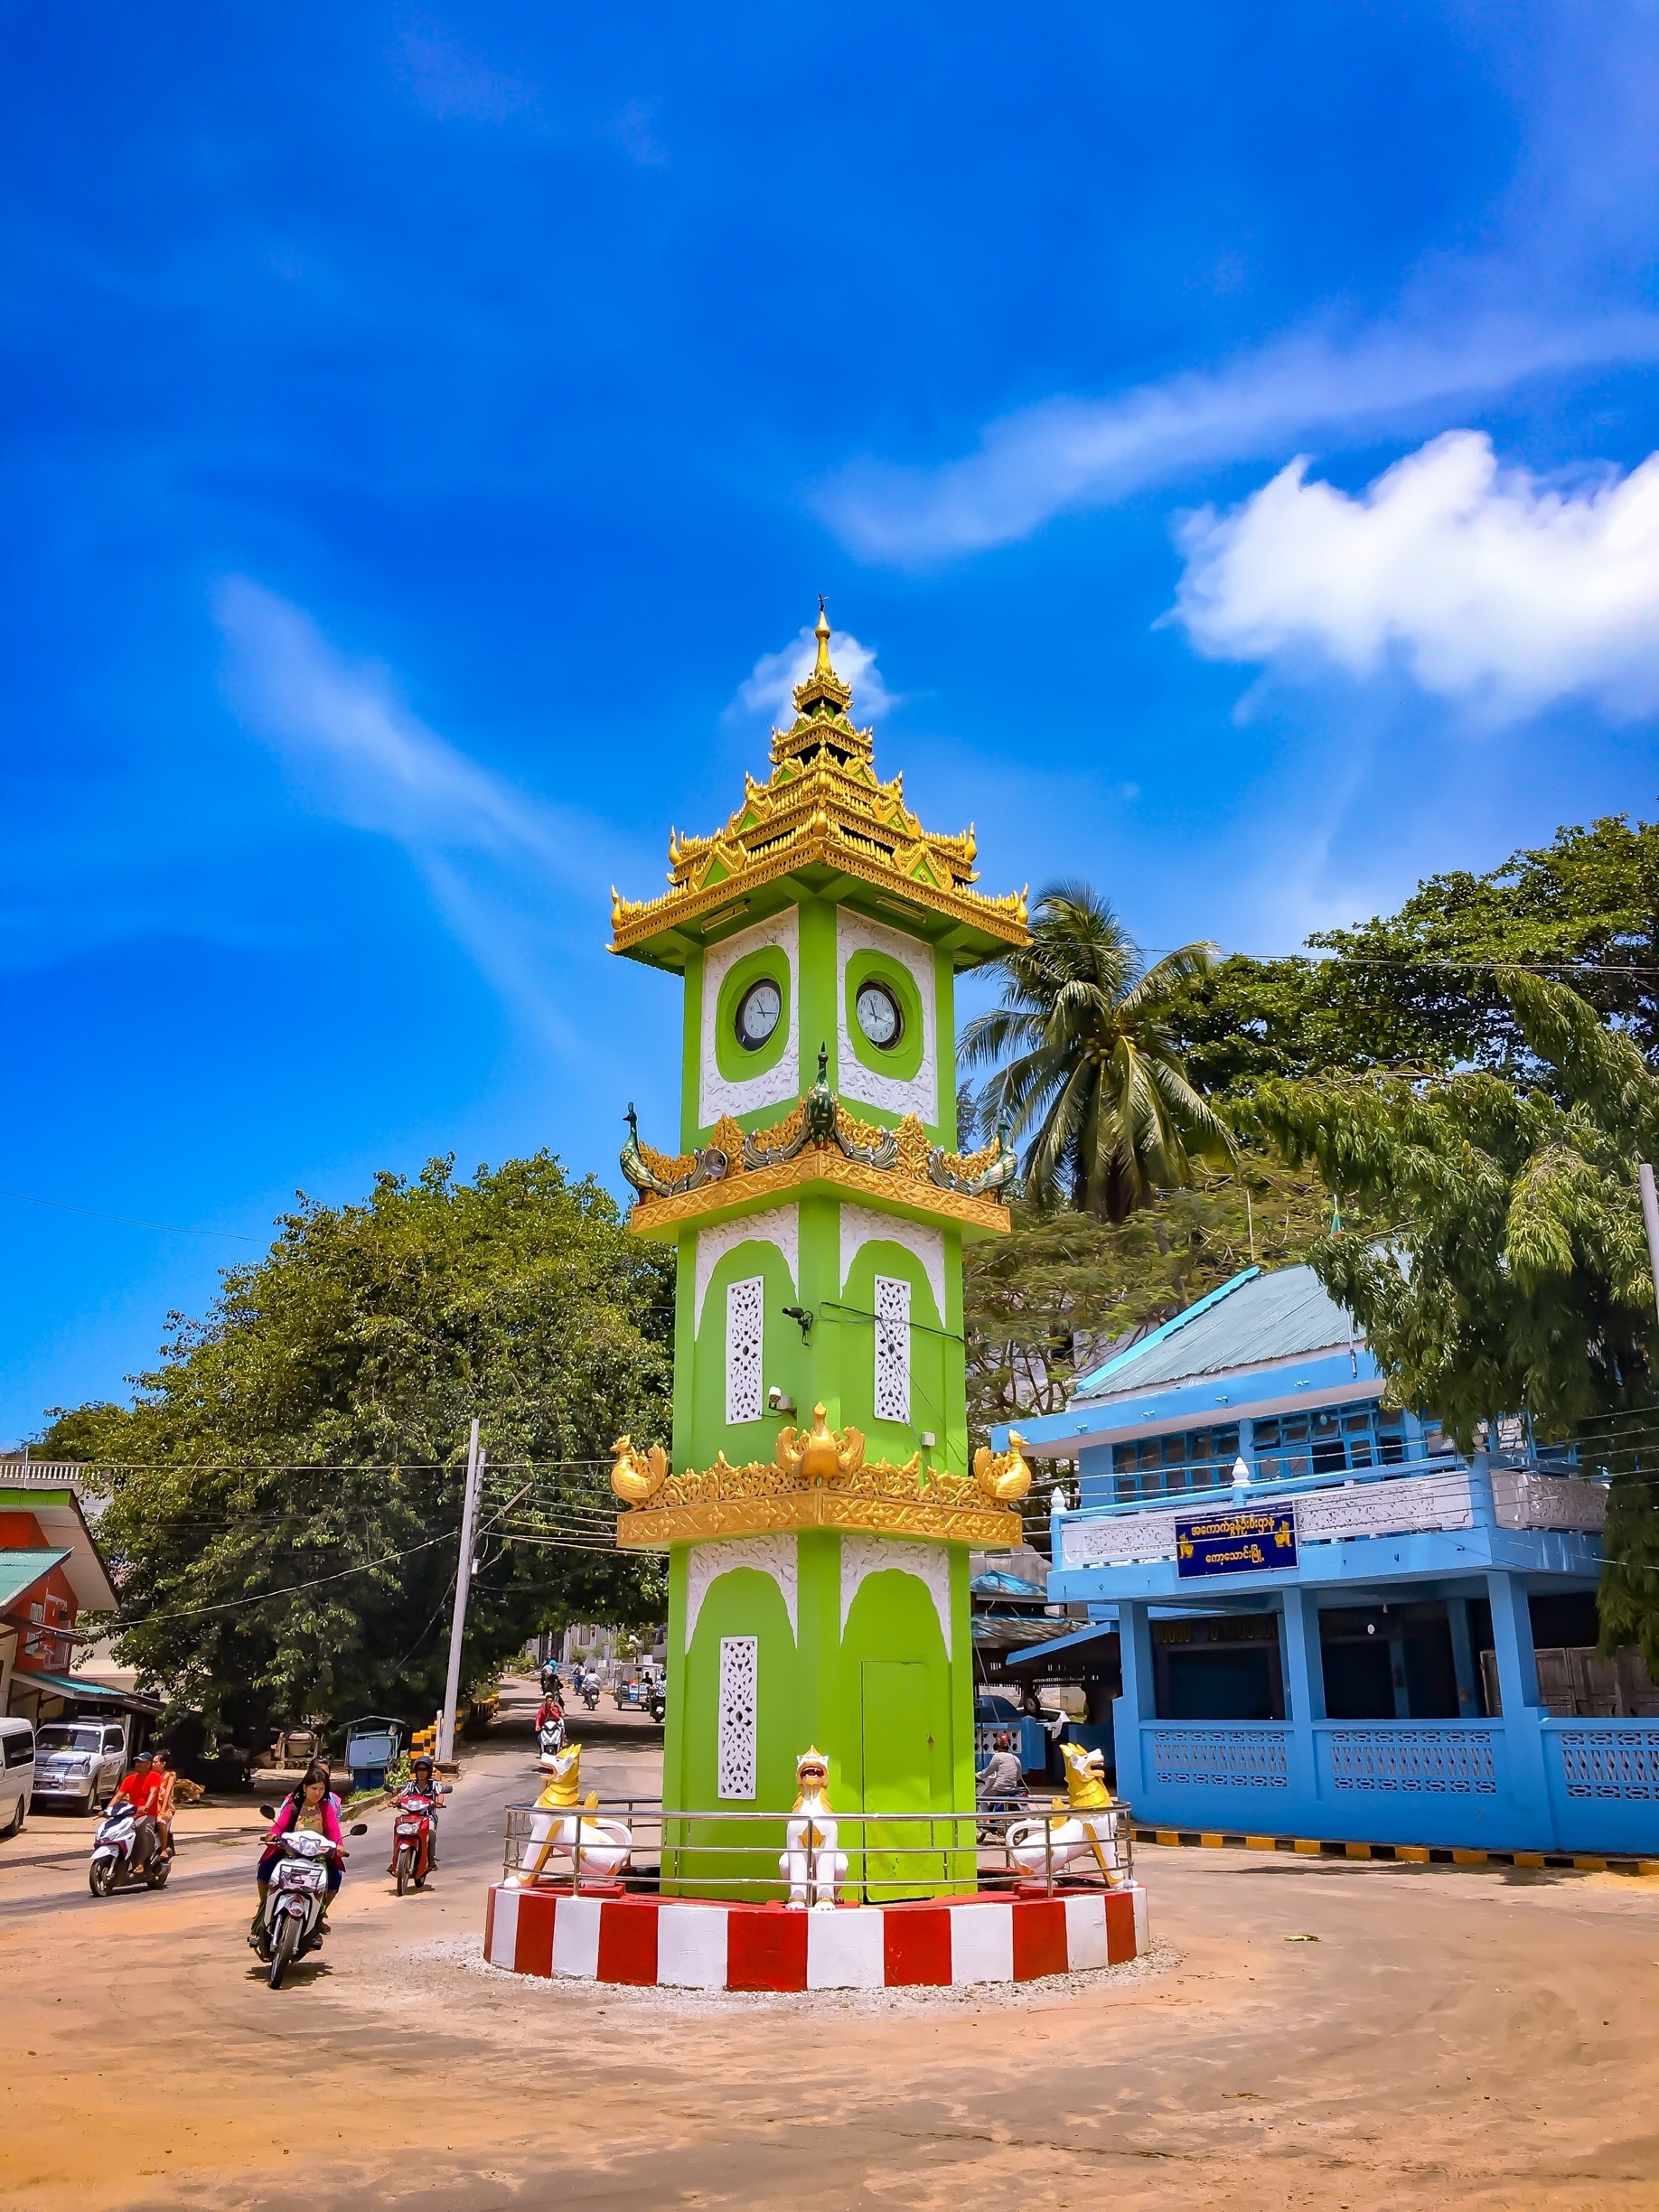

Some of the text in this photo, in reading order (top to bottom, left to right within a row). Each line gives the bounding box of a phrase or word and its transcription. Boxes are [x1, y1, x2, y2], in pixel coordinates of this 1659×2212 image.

[1205, 1543, 1265, 1566] ကော့သောင်းမြို့
